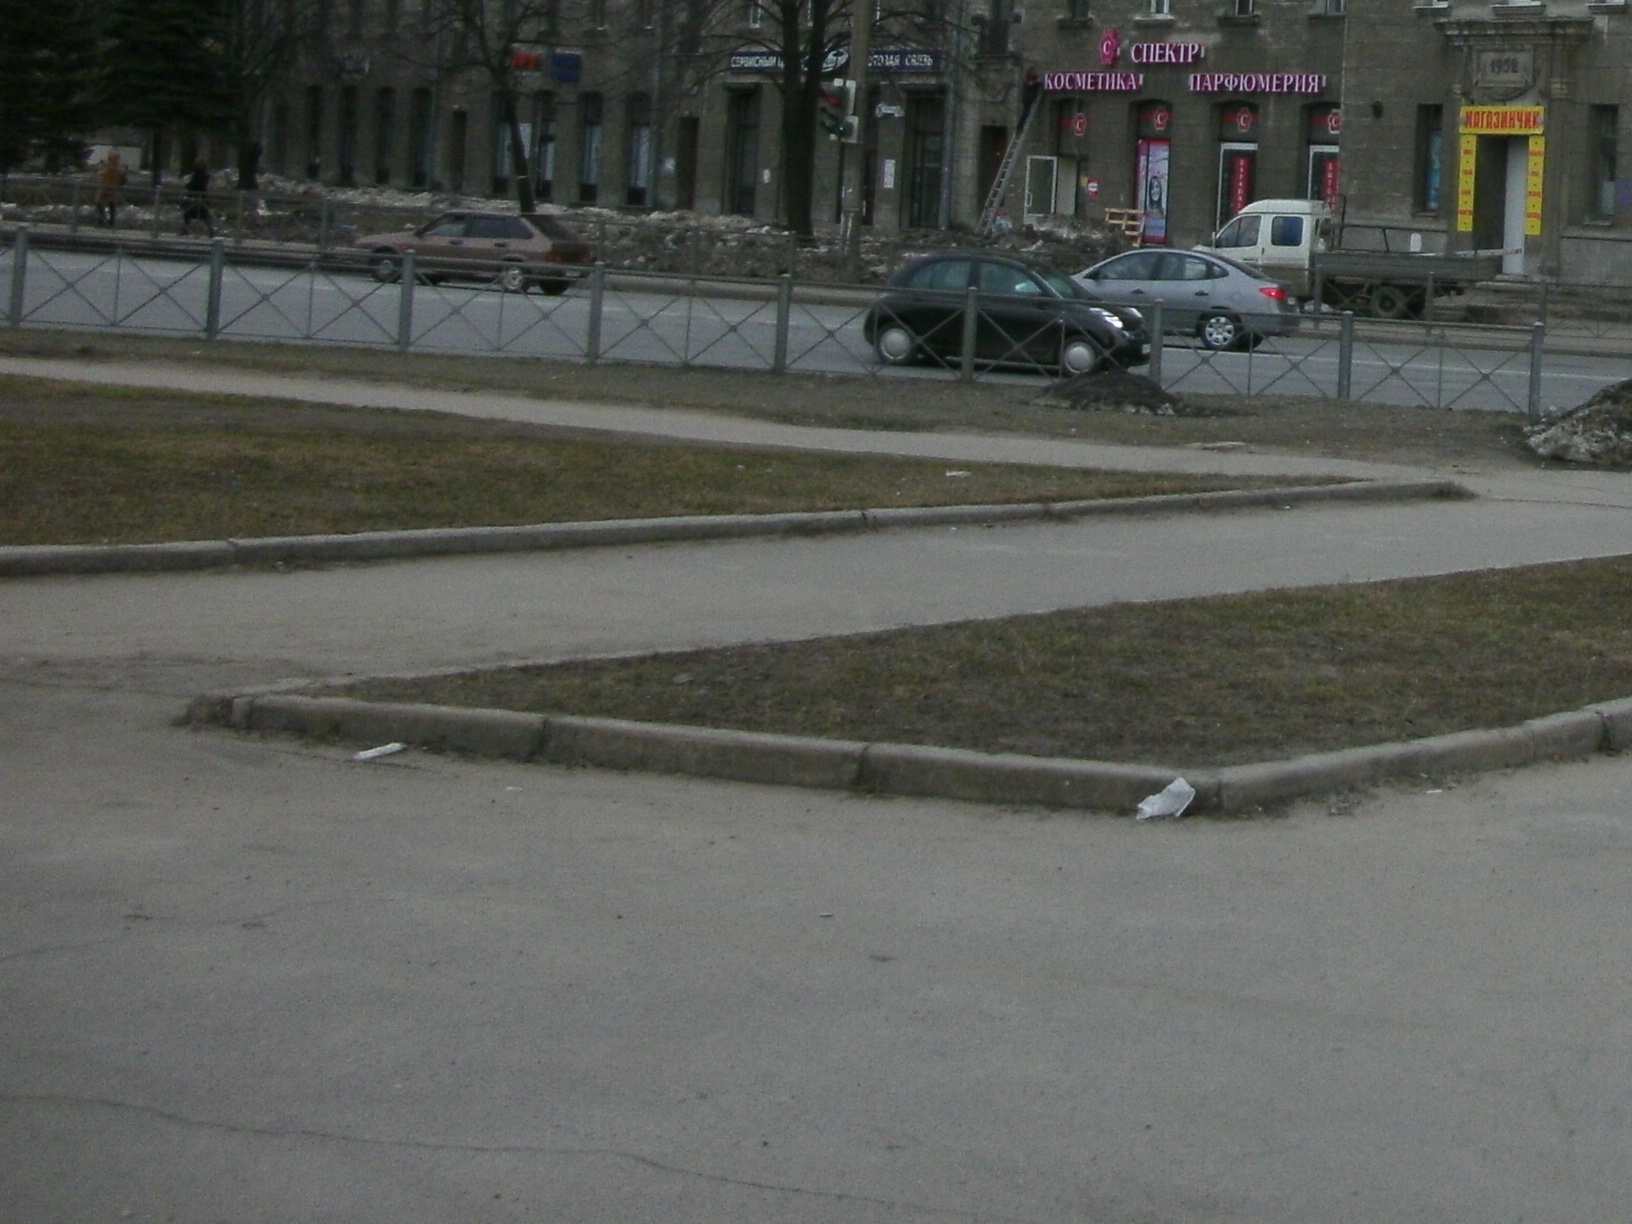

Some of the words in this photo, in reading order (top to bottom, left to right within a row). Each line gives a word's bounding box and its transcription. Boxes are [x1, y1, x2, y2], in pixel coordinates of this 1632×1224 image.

[1131, 42, 1200, 63] СПЕКТР
[1045, 73, 1138, 91] КОСМЕТИКА
[1189, 74, 1320, 93] ПАРФЮМЕРИЯ
[1464, 111, 1540, 129] МАГАЗИНЧИК
